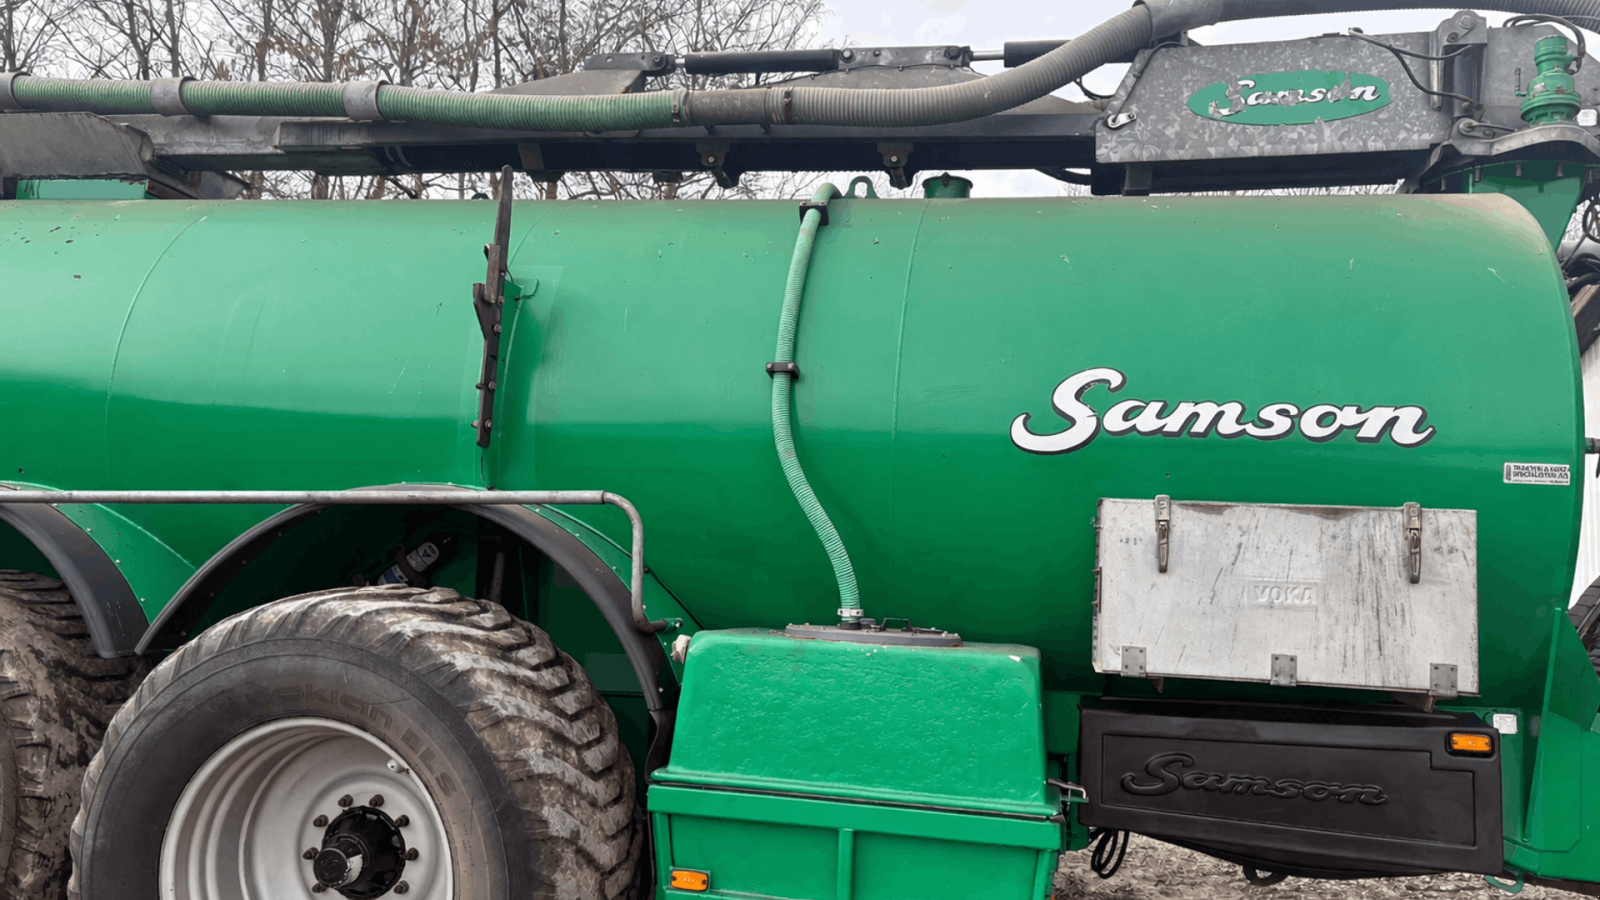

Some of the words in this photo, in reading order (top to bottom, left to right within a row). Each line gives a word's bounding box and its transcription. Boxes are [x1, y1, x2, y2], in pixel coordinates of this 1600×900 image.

[1208, 79, 1381, 116] Sasn
[1010, 367, 1436, 455] Samson
[1253, 585, 1317, 604] VOKA
[1120, 752, 1388, 806] Samson
